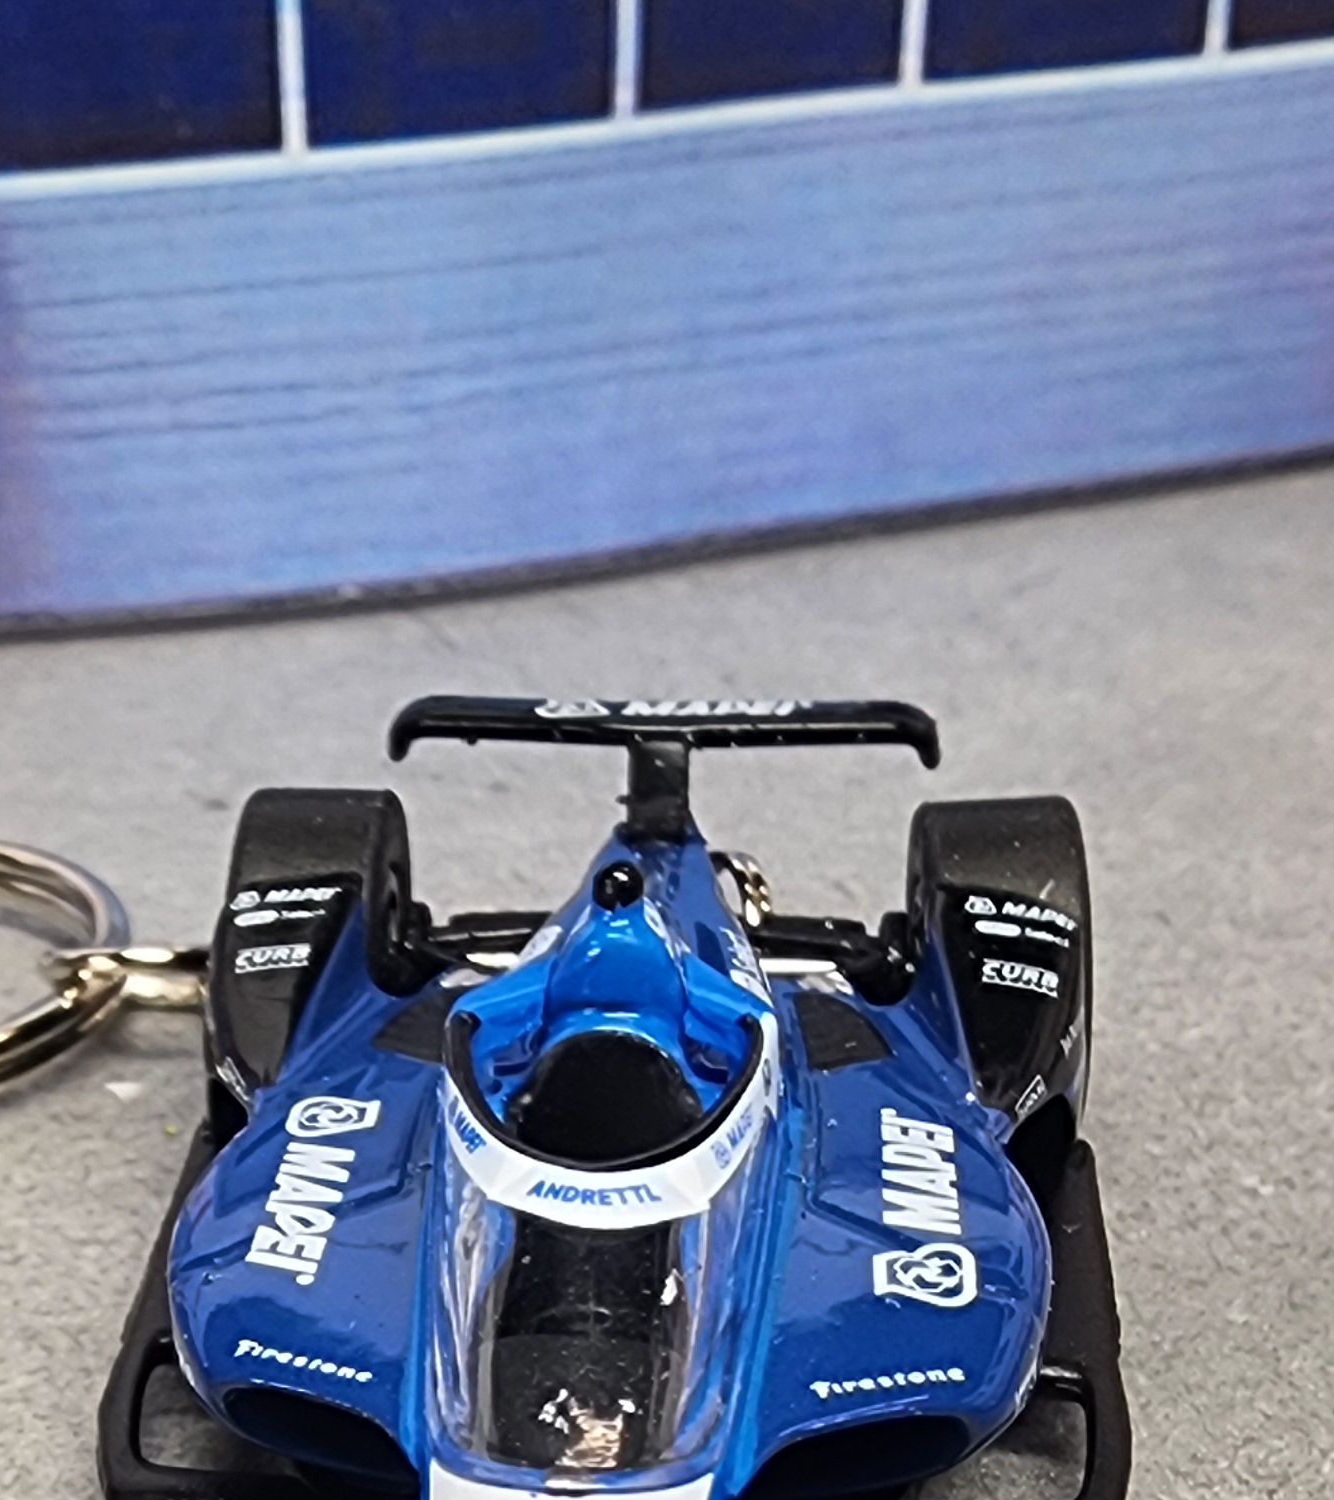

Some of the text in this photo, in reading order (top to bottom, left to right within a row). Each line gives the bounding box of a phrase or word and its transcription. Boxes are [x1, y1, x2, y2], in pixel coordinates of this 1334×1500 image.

[245, 1142, 356, 1285] MAPEI
[880, 1108, 962, 1235] MAPEI
[233, 1339, 373, 1382] Firestone
[809, 1367, 966, 1399] Firestone
